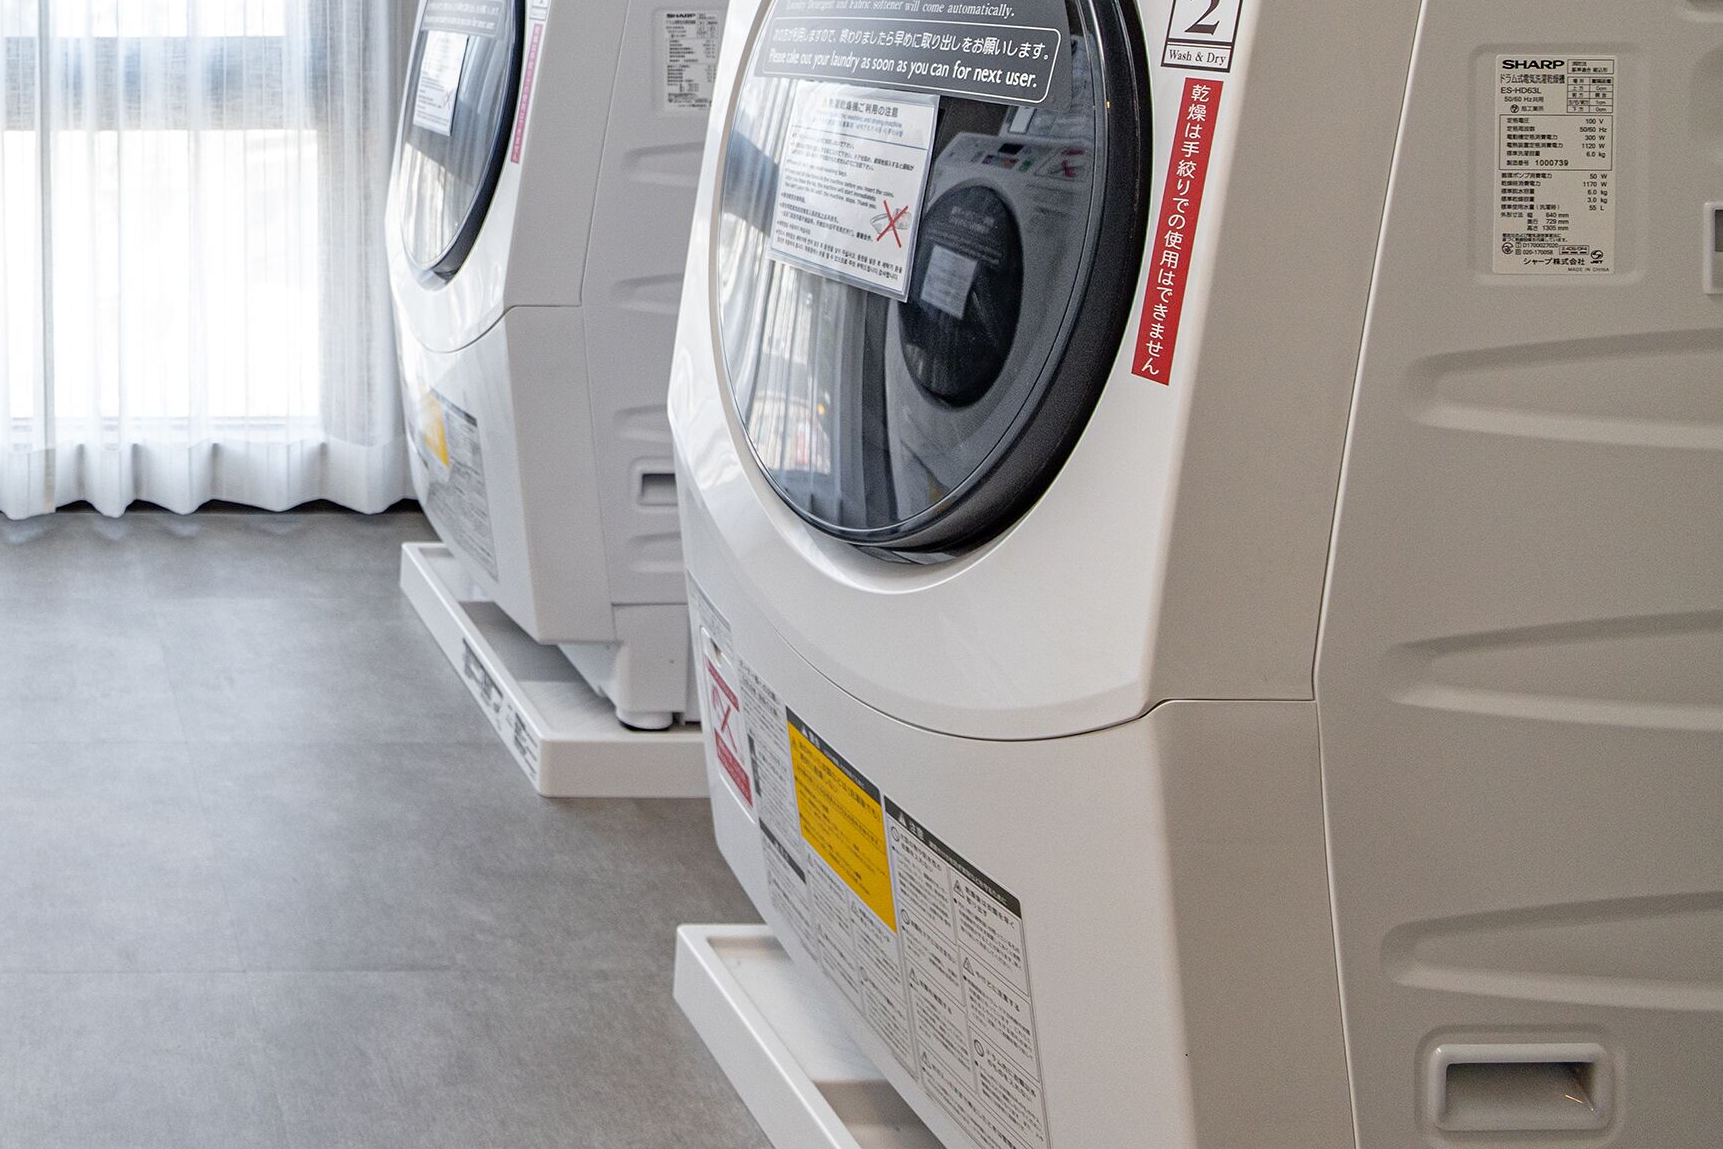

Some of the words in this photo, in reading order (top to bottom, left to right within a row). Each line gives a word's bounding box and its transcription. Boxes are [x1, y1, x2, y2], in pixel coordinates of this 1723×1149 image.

[872, 0, 904, 11] softener
[904, 0, 920, 12] will
[922, 2, 945, 14] come
[947, 2, 1015, 19] automatically.
[1168, 49, 1191, 63] Wash
[1194, 51, 1203, 64] &
[1206, 52, 1227, 67] Dry
[768, 48, 785, 64] Please
[785, 48, 800, 64] take
[800, 51, 812, 64] out
[812, 54, 831, 70] your
[830, 50, 860, 73] laundry
[860, 57, 871, 70] as
[871, 57, 895, 72] soon
[896, 60, 908, 73] as
[907, 61, 929, 80] you
[930, 63, 950, 77] can
[951, 60, 972, 80] for
[973, 67, 1003, 84] next
[1005, 71, 1038, 89] user.
[1501, 59, 1565, 70] SHARP
[1500, 86, 1542, 94] ES-HD63L
[1534, 159, 1569, 167] 1000739
[1600, 189, 1608, 197] kg
[1140, 83, 1212, 377] 乾燥は手絞りでの使用はできません
[1523, 257, 1586, 266] シャープ株式会社
